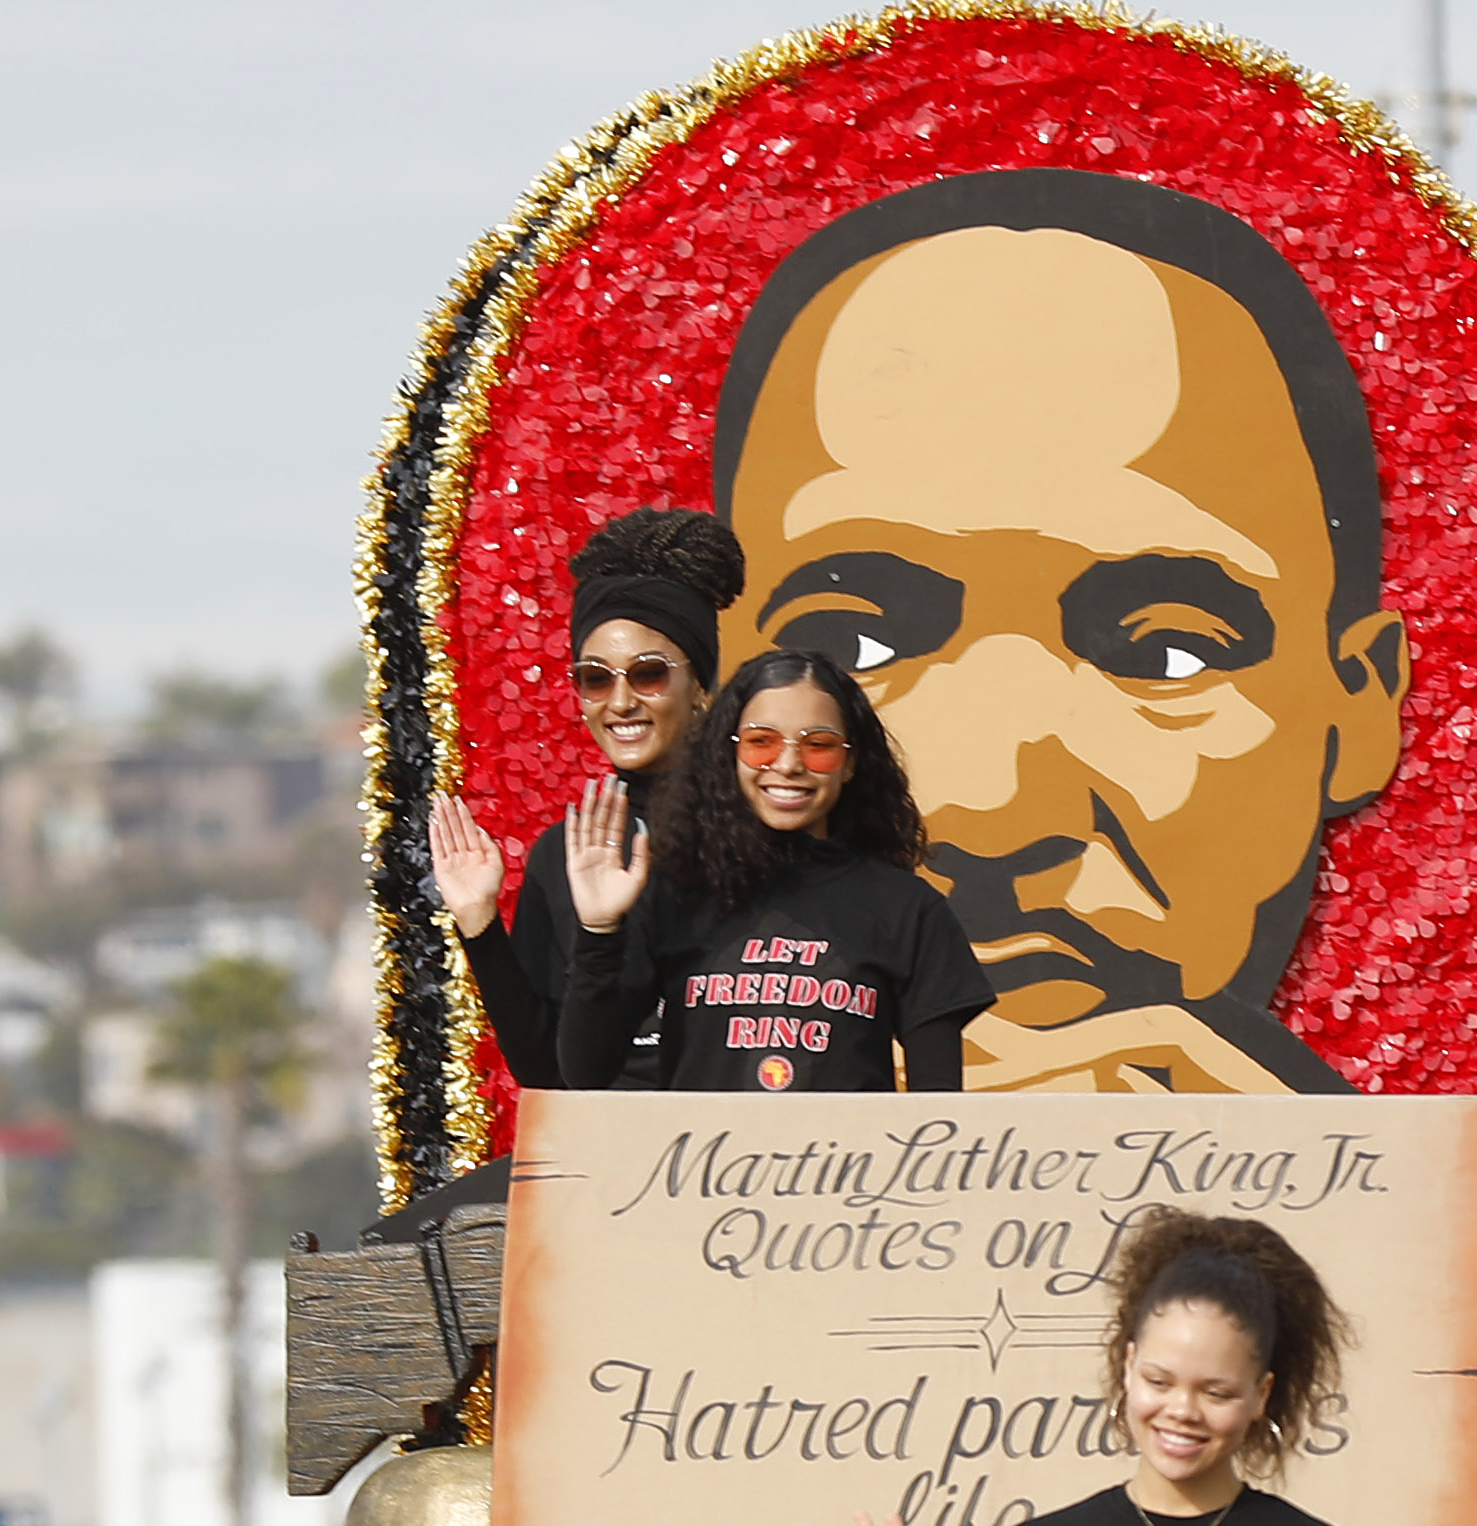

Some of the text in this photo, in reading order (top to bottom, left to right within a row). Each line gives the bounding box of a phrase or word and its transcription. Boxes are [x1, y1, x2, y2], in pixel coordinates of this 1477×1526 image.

[741, 936, 828, 967] LET
[685, 973, 878, 1019] FREEDOM
[726, 1016, 832, 1052] RING
[611, 1130, 874, 1217] Martin
[842, 1119, 1100, 1209] Luther
[1280, 1133, 1390, 1212] Jr.
[701, 1206, 964, 1280] Quotes
[985, 1218, 1073, 1270] on
[589, 1359, 929, 1479] Hatred
